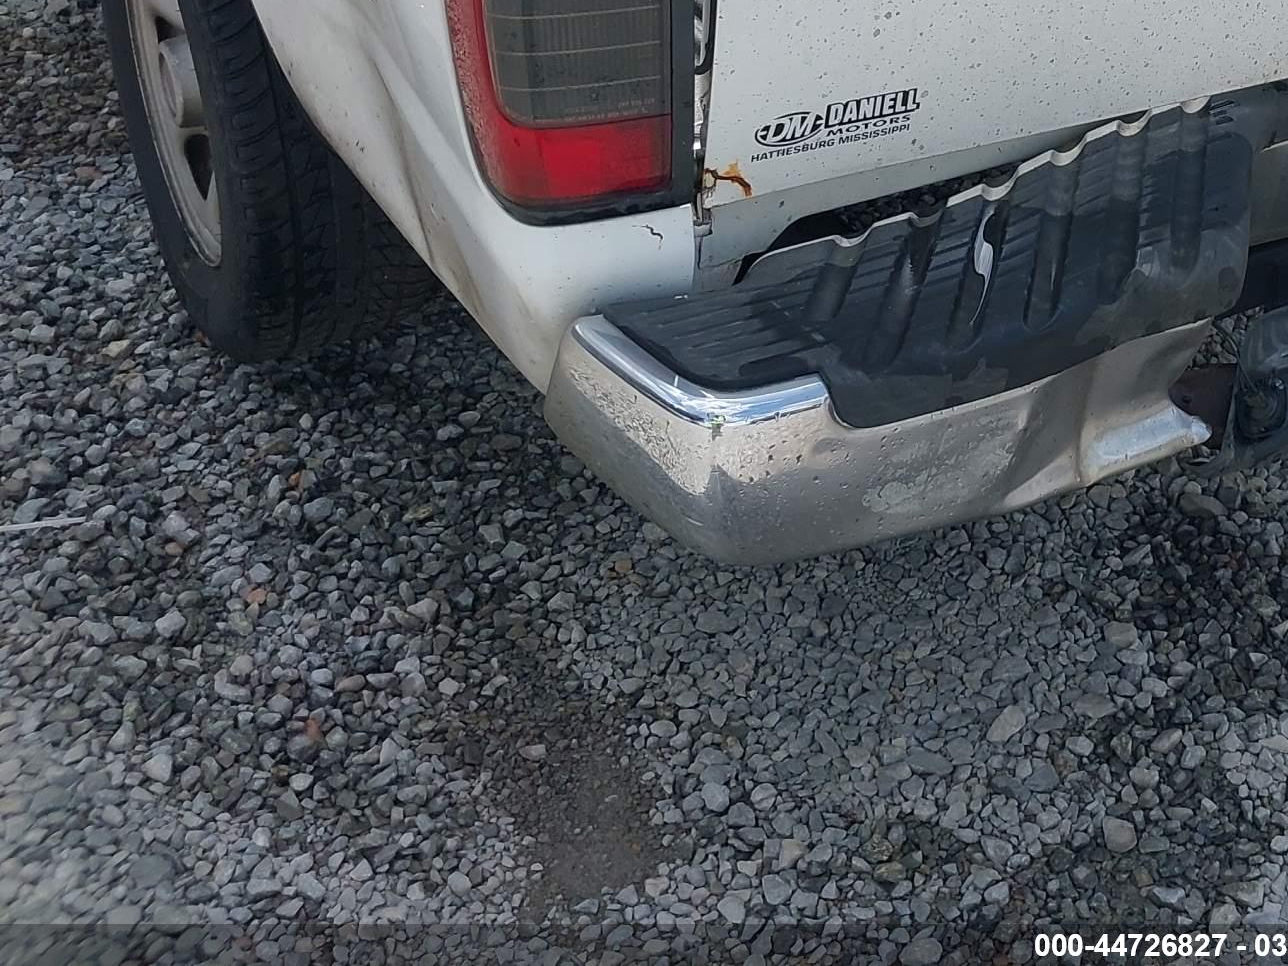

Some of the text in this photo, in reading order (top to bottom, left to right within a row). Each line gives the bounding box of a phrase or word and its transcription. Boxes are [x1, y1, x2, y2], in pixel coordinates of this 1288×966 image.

[825, 88, 920, 128] DANIELL
[826, 114, 911, 137] MOTORS
[751, 124, 910, 163] HATTIESBURG MISSISSIPPI
